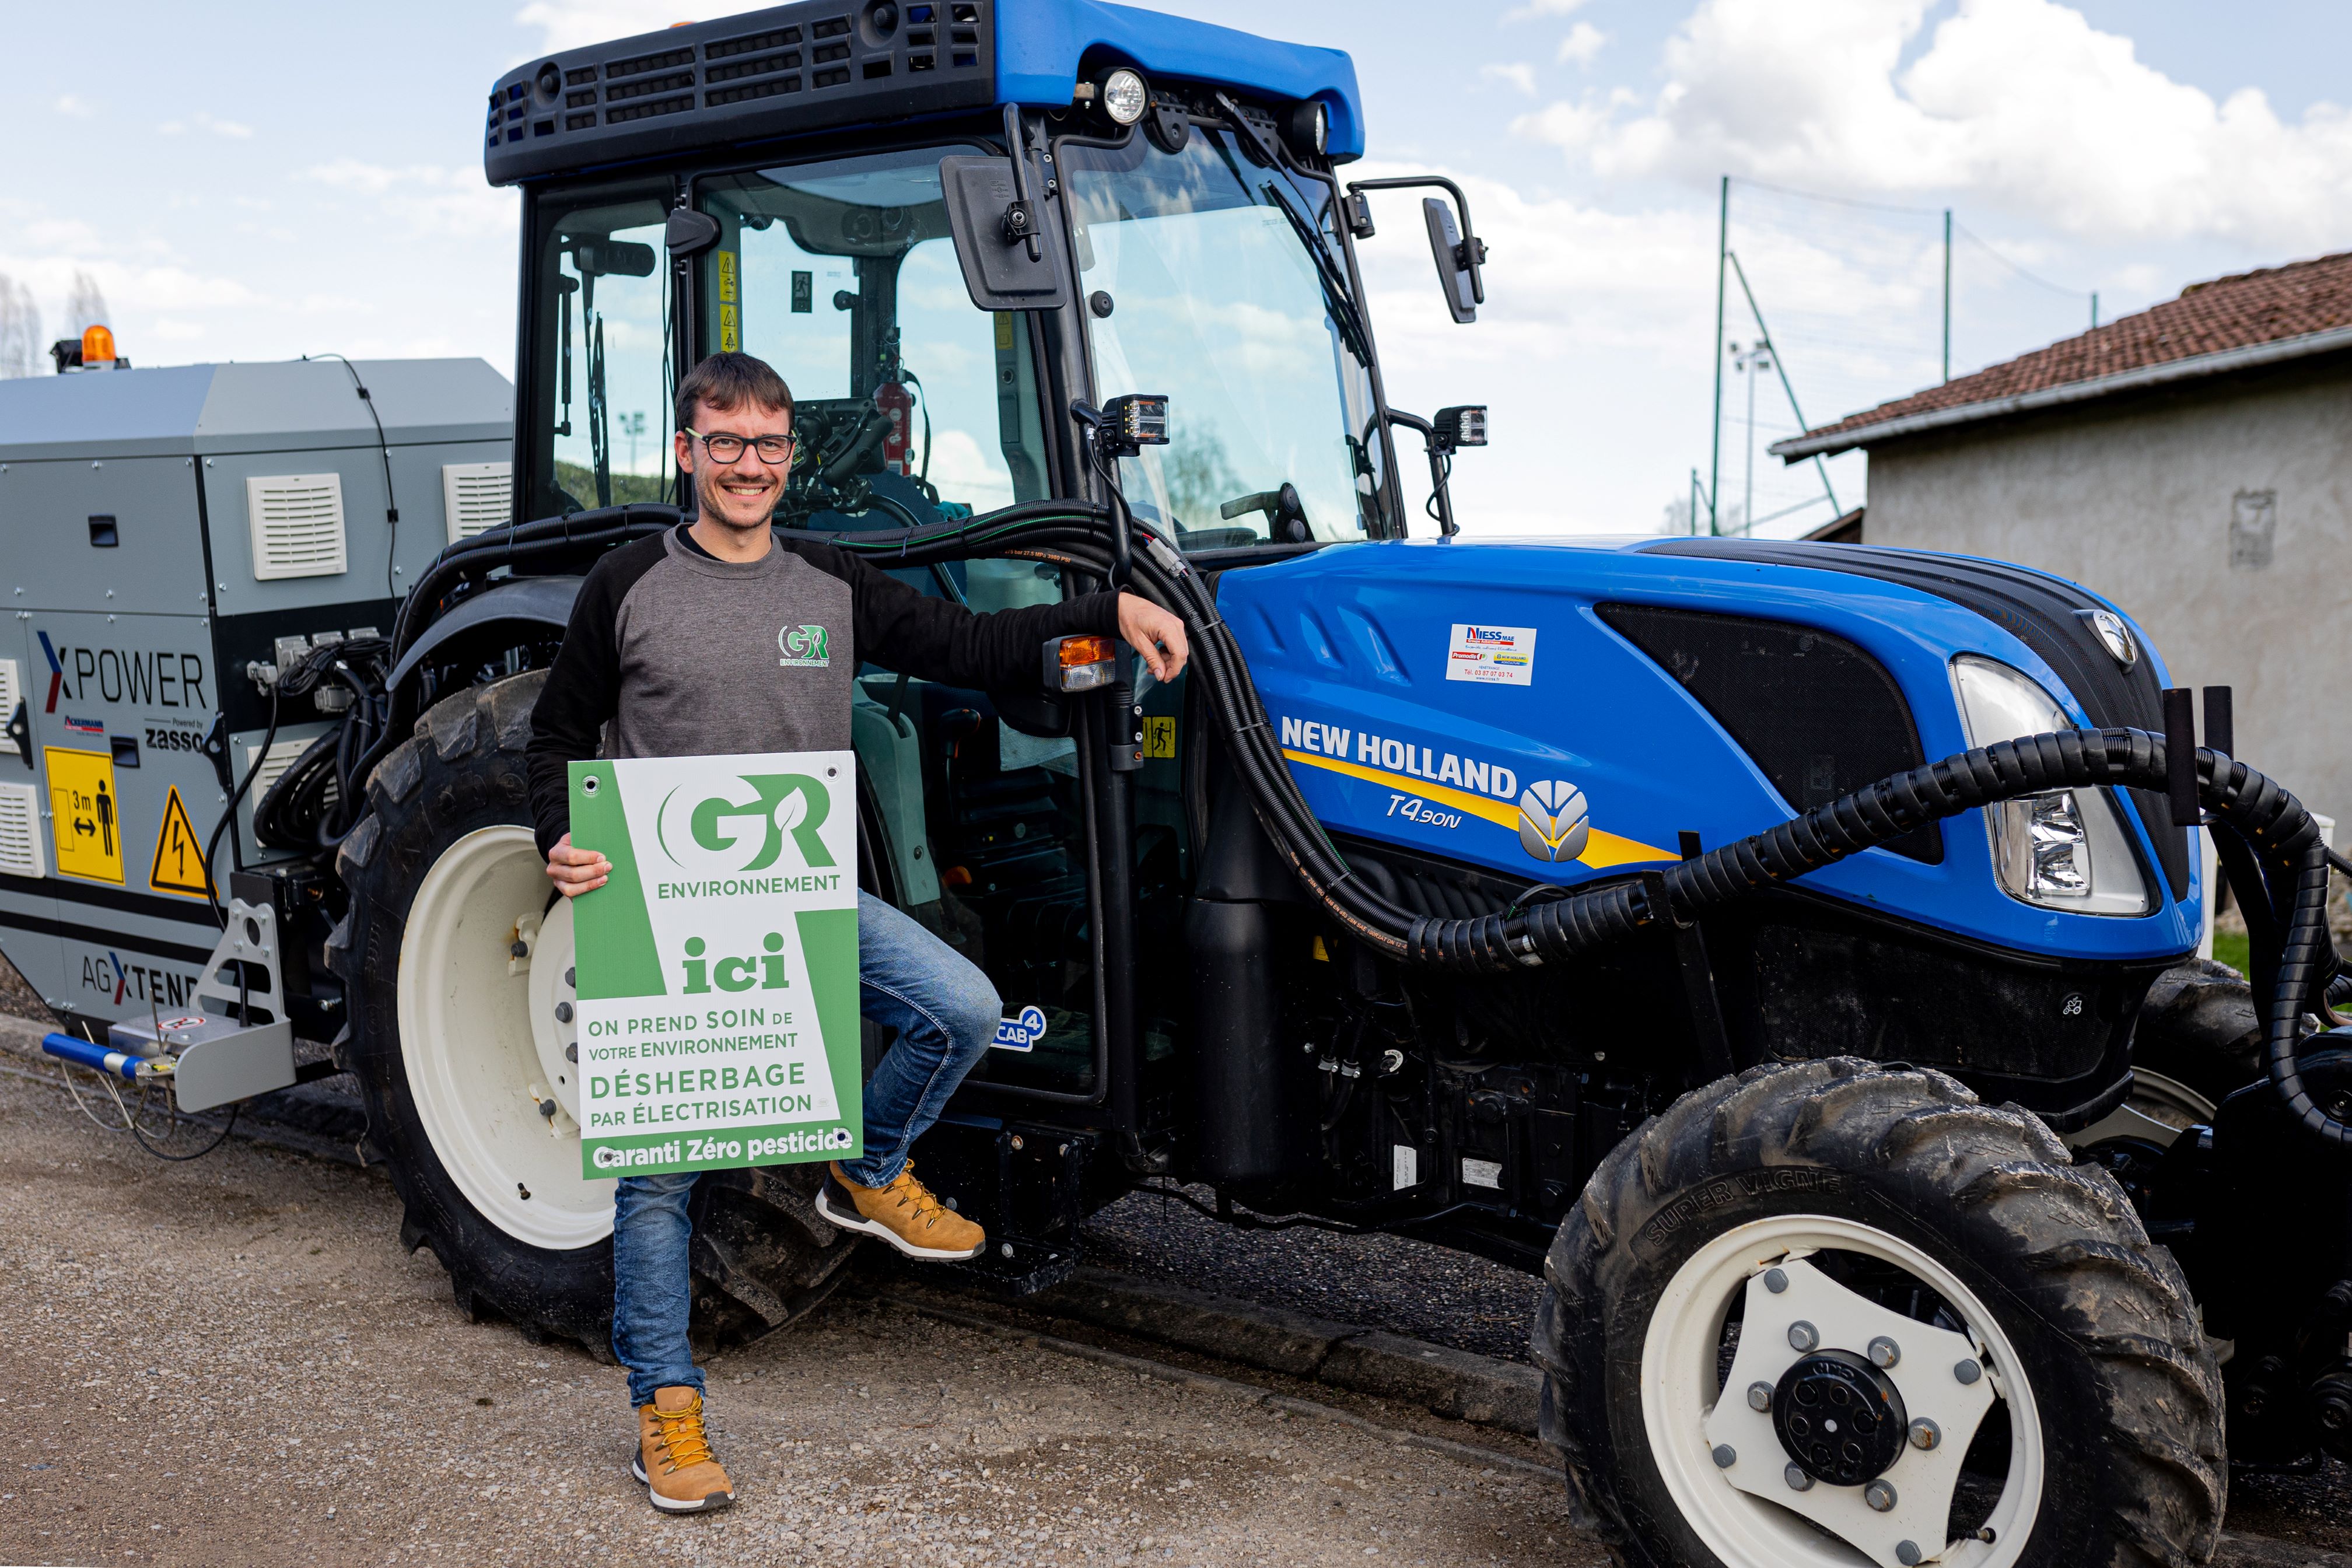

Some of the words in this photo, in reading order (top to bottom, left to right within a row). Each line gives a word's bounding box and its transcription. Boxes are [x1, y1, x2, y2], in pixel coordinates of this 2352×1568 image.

[780, 659, 830, 667] ENVIRONNEMENT
[65, 715, 103, 728] ACKERMANN
[173, 718, 195, 728] Powered
[196, 719, 203, 729] by
[145, 728, 204, 753] zasso
[1282, 716, 1350, 758] NEW
[1357, 732, 1518, 800] HOLLAND
[72, 790, 79, 810] 3
[81, 795, 92, 811] m
[1386, 794, 1462, 830] T4.90N
[657, 874, 841, 900] ENVIRONNEMENT
[1308, 877, 1318, 888] 2SN
[1316, 887, 1325, 897] ISO
[1332, 904, 1340, 912] EN
[1347, 916, 1358, 926] 2SN
[1357, 923, 1368, 932] SAE
[682, 932, 789, 995] ici
[588, 1020, 618, 1037] ON
[628, 1014, 698, 1035] PREND
[706, 1008, 765, 1029] SOIN
[772, 1012, 793, 1026] DE
[996, 1026, 1027, 1044] CAB
[1024, 1013, 1041, 1031] 4
[589, 1046, 636, 1061] VOTRE
[641, 1032, 798, 1058] ENVIRONNEMENT
[590, 1062, 806, 1100] DÉSHERBAGE
[590, 1111, 626, 1128] PAR
[633, 1094, 812, 1125] ÉLECTRISATION
[687, 1136, 741, 1162] Zéro
[1645, 1181, 1734, 1247] SUPER
[1735, 1170, 1842, 1195] VIGNE
